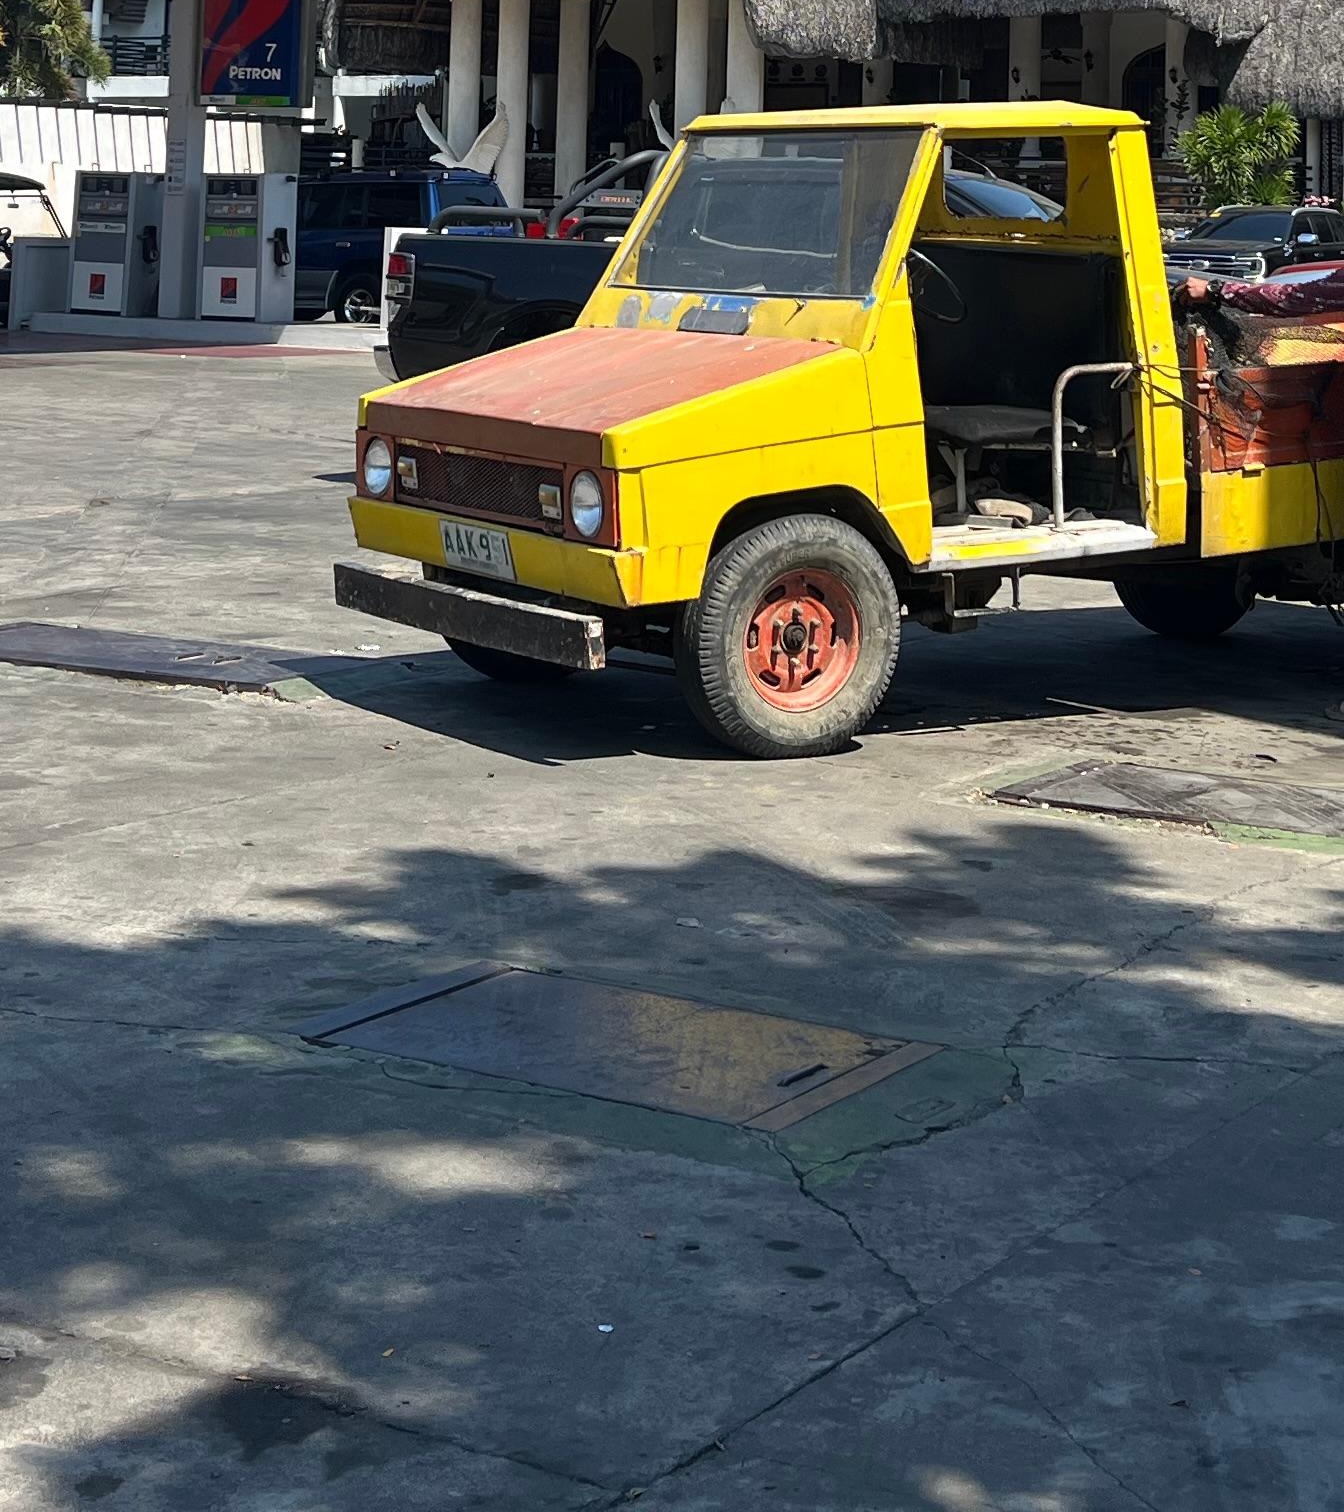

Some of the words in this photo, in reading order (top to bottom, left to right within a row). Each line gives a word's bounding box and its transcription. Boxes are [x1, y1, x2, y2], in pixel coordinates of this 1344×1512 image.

[265, 43, 277, 62] 7
[229, 65, 281, 80] PETRON
[444, 524, 478, 559] AAK
